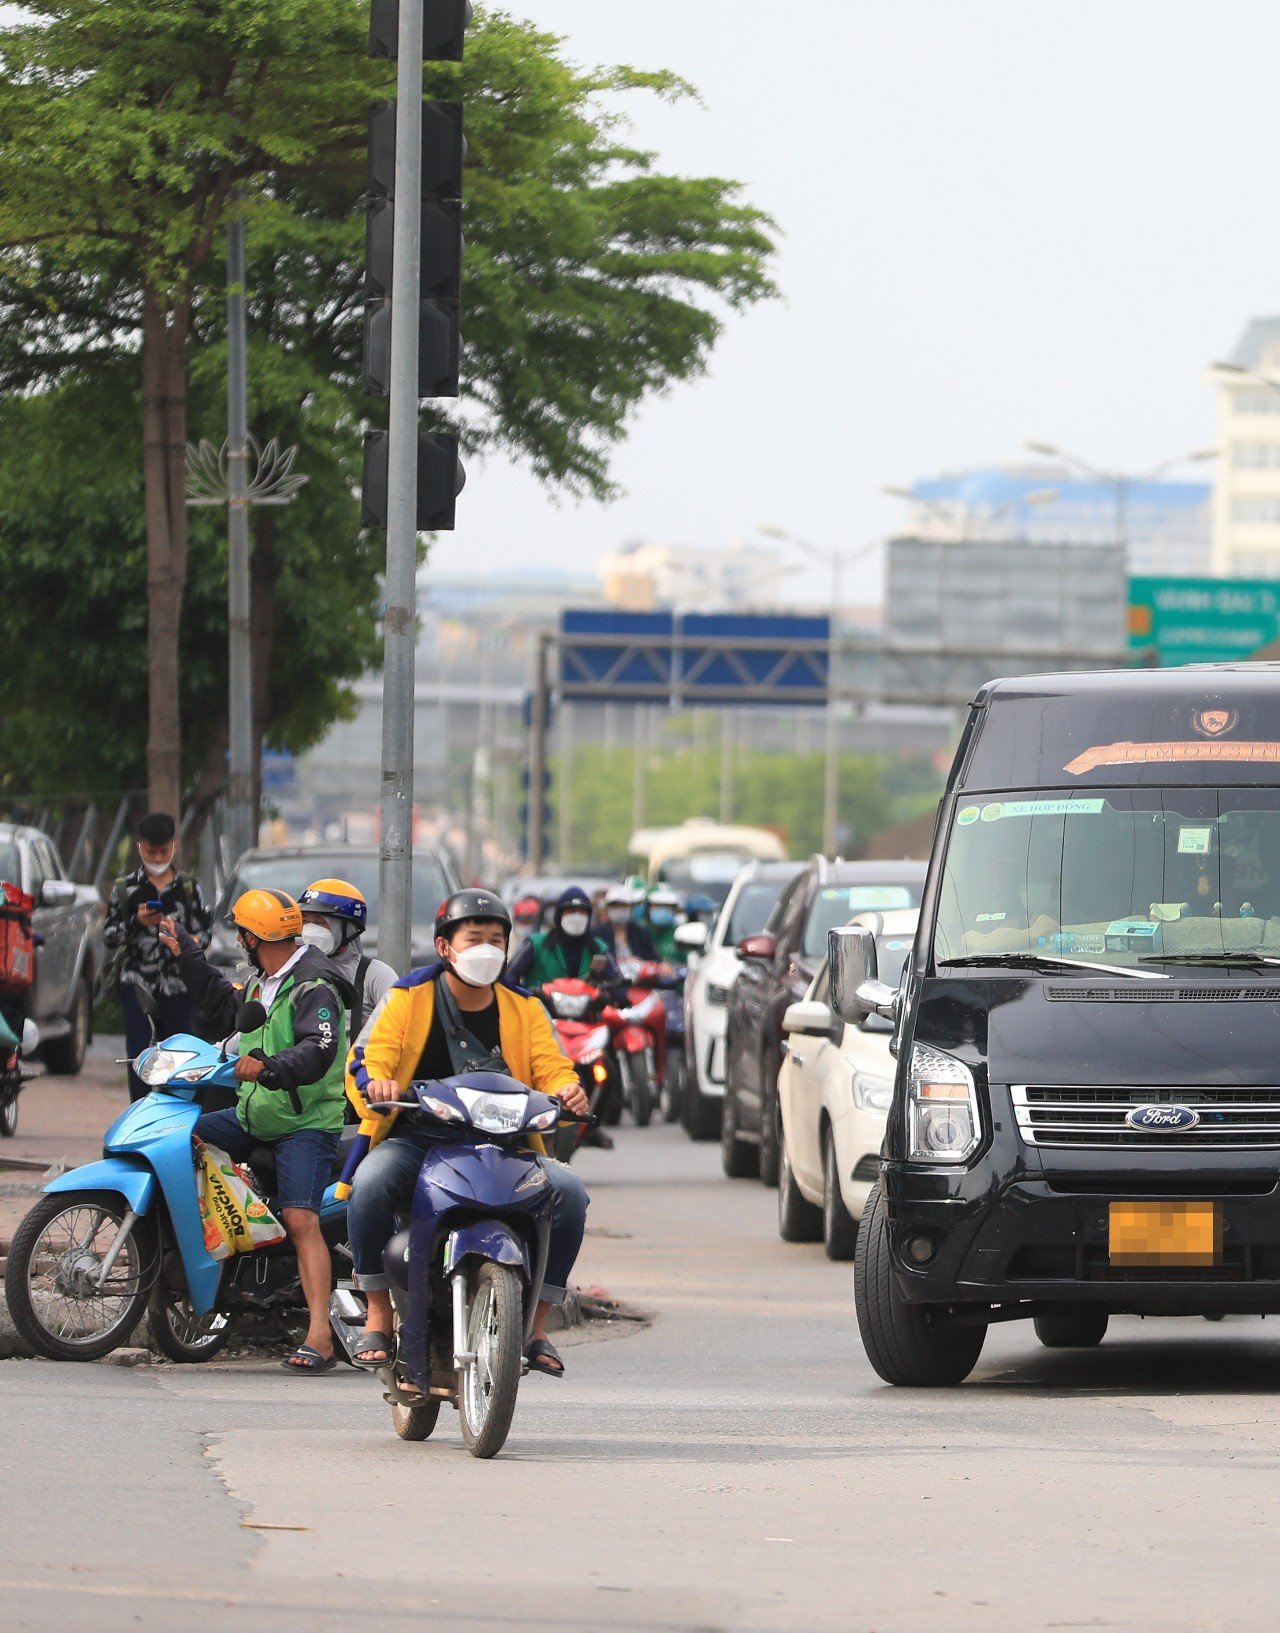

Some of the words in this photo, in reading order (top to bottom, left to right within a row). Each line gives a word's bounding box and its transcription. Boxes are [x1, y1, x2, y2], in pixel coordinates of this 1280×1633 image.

[304, 890, 320, 899] be
[1142, 1107, 1182, 1125] Ford
[208, 1172, 245, 1237] BONCHA
